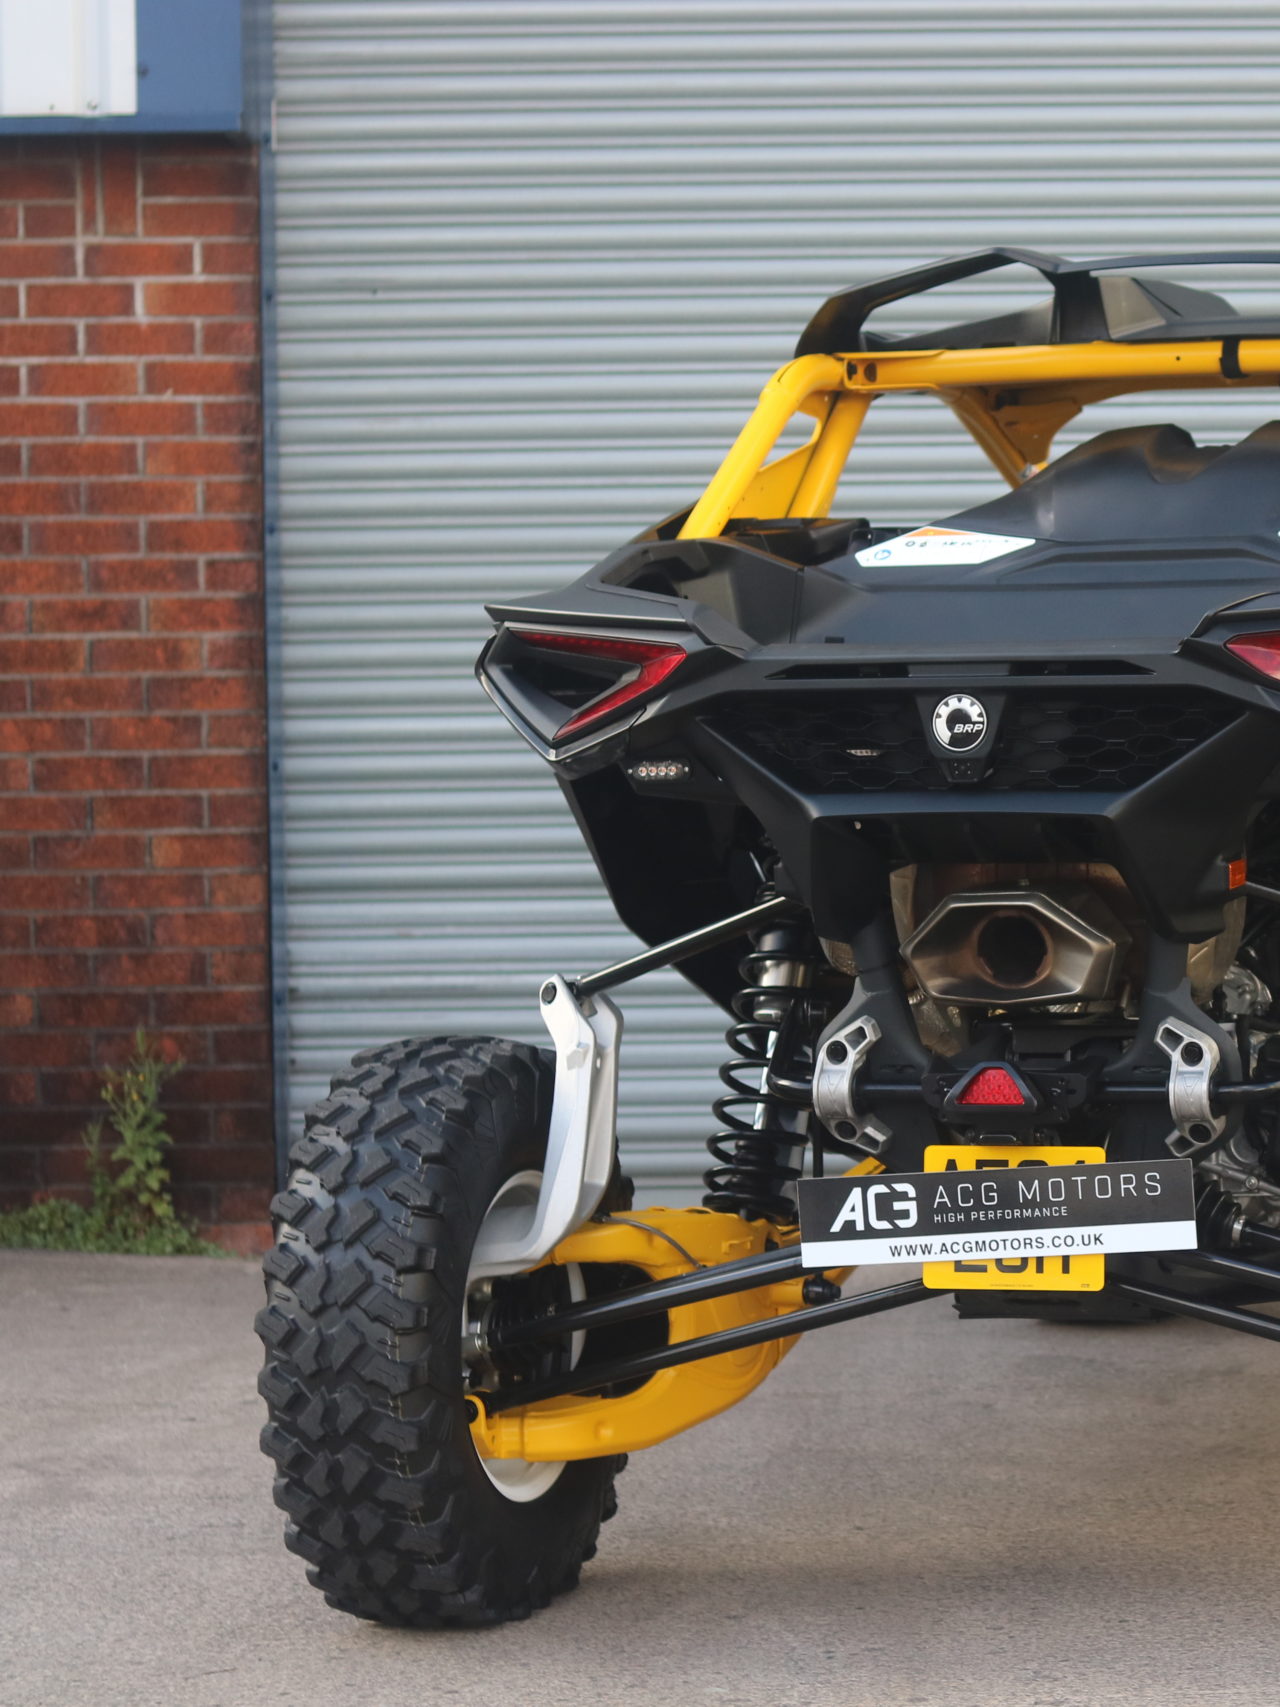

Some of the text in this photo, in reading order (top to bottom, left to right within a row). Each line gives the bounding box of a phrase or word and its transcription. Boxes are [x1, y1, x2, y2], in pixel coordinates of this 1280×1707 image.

[953, 723, 983, 733] BRP
[934, 1172, 1162, 1208] ACG MOTORS
[829, 1182, 918, 1232] ACG
[934, 1206, 1068, 1223] HIGH PERFORMANCE
[889, 1233, 1104, 1257] WWW.ACGMOTORS.CO.UK
